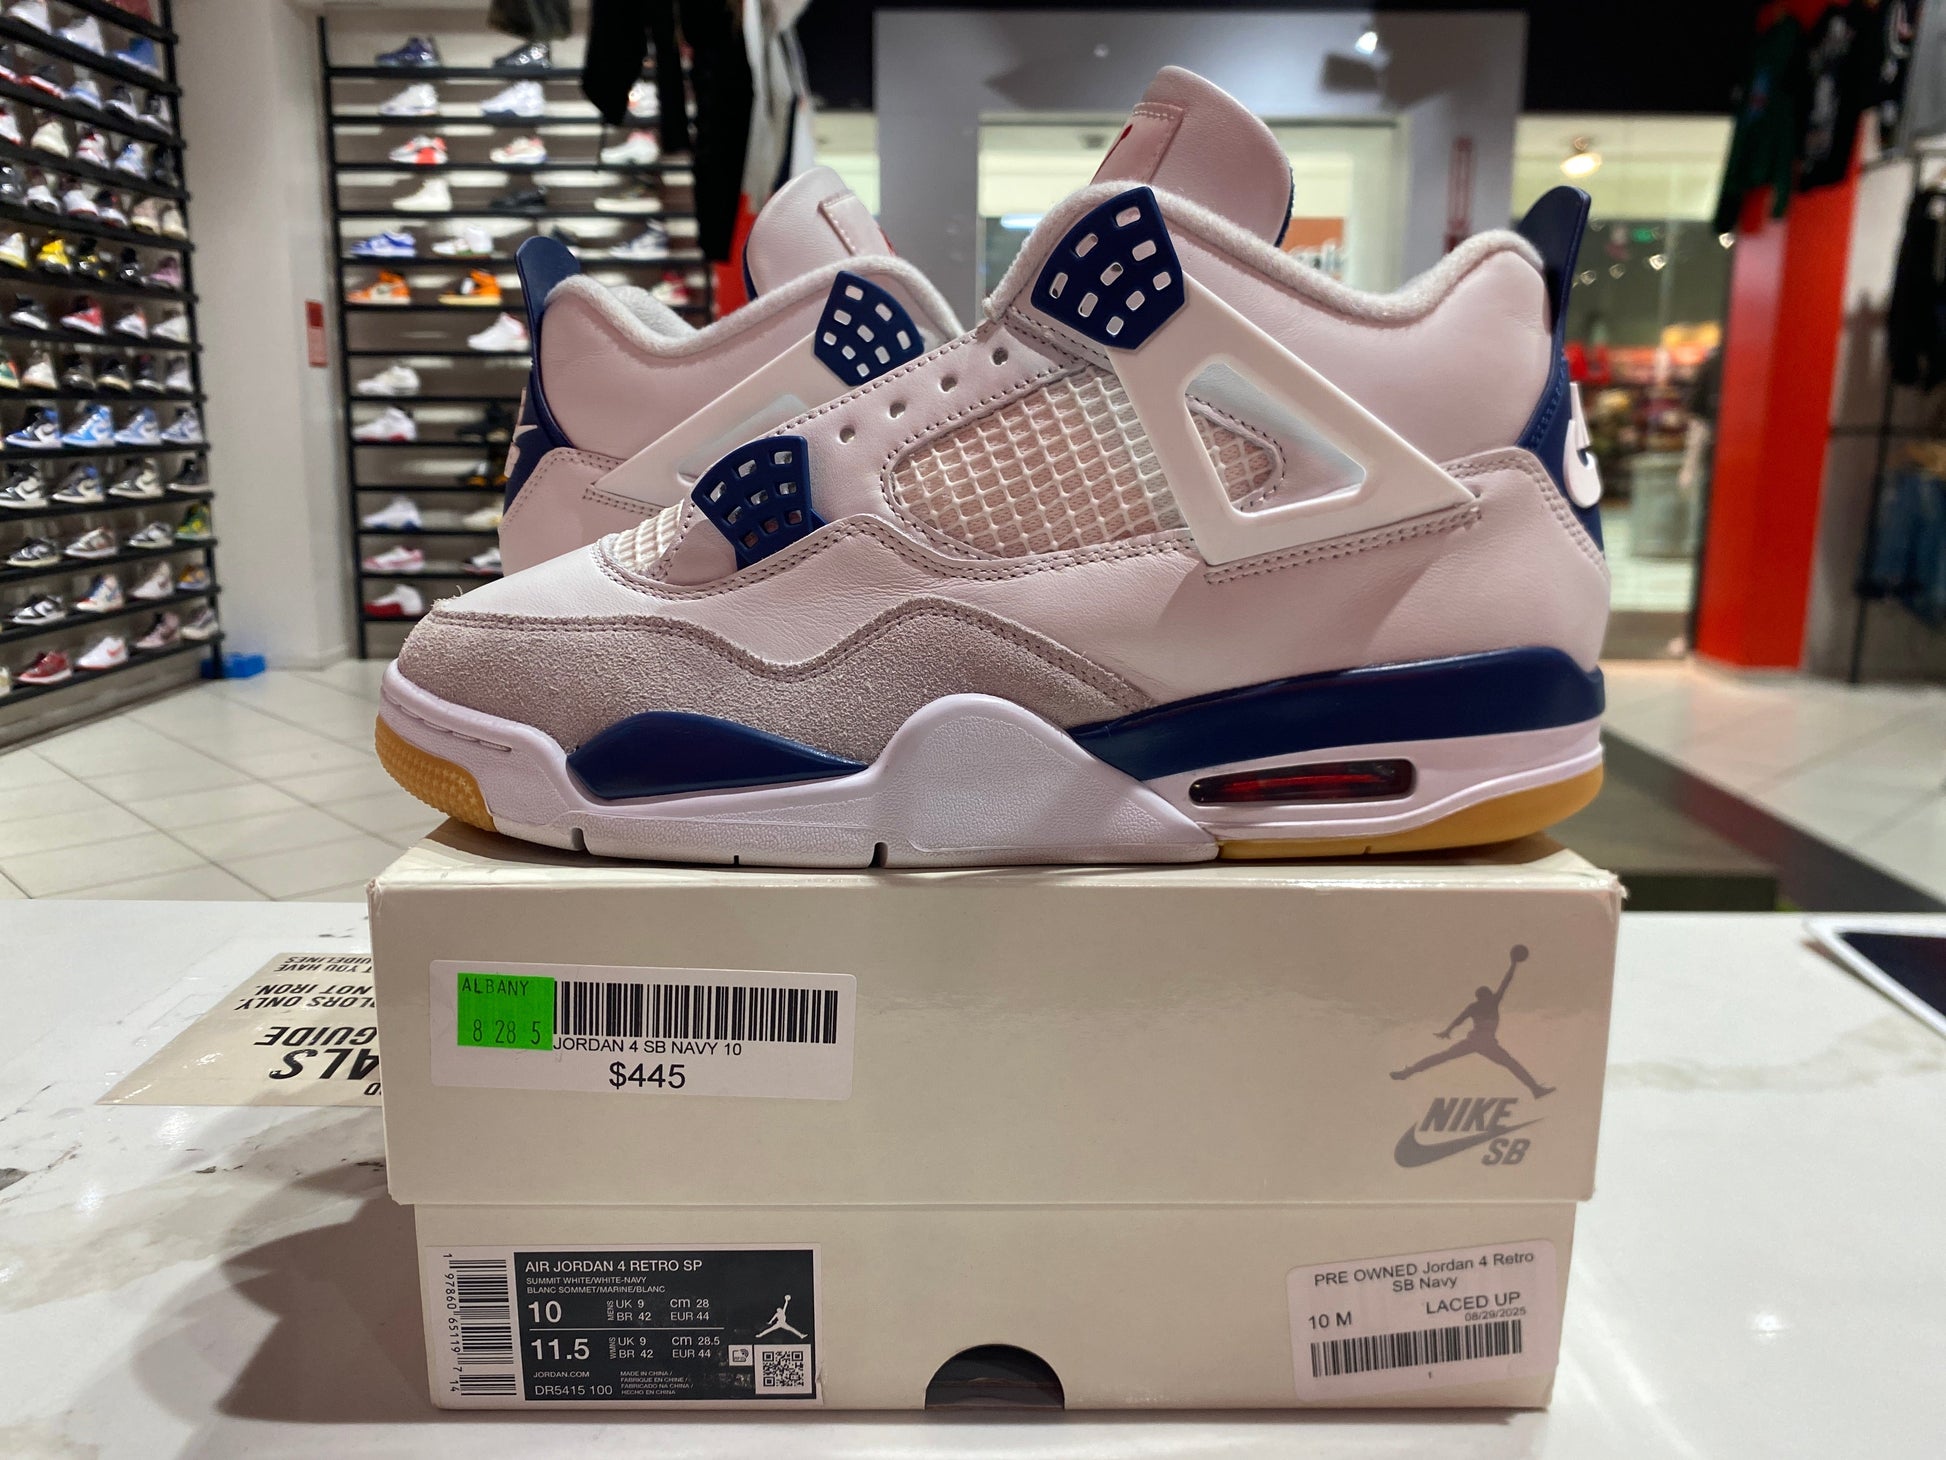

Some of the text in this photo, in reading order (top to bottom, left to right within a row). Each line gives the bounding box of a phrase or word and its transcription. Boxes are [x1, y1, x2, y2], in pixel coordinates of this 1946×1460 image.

[273, 963, 322, 972] HAVE
[323, 964, 358, 973] YOU
[255, 983, 373, 996] NOT IRON.
[461, 977, 530, 996] ALBANY
[233, 996, 376, 1011] LORS ONLY.
[253, 1026, 378, 1047] GUIDE
[472, 1019, 541, 1045] 8 28 5
[553, 1038, 742, 1056] JORDAN 4 SB NAVY 10
[608, 1061, 686, 1090] $445
[1419, 1097, 1518, 1133] NIKE
[1481, 1138, 1531, 1166] SB
[525, 1259, 703, 1273] AIR JORDAN 4 RETRO SP
[1314, 1252, 1535, 1287] PRE OWNED Jordan 4 Retro
[526, 1276, 647, 1285] SUMMIT WHITE/WHITE-NAVY
[1392, 1276, 1458, 1293] SB Navy
[444, 1273, 457, 1310] 97860
[527, 1285, 666, 1294] BLANC SOMMET/MARINE/BLANC
[606, 1300, 615, 1321] MENS
[615, 1299, 645, 1308] UK 9
[670, 1298, 710, 1308] cm 28
[1425, 1291, 1521, 1315] LACED UP
[528, 1300, 562, 1323] 10
[616, 1311, 652, 1321] BR 42
[670, 1311, 710, 1321] EUR 44
[1464, 1306, 1527, 1322] 08/29/2025
[1308, 1311, 1353, 1330] 10 M
[531, 1338, 590, 1360] 11.5
[609, 1336, 617, 1360] WMNS
[618, 1336, 647, 1346] UK 9
[671, 1336, 720, 1346] cm 28.5
[619, 1349, 654, 1359] BR 42
[672, 1349, 711, 1358] EUR 44
[535, 1385, 613, 1395] DR5415 100
